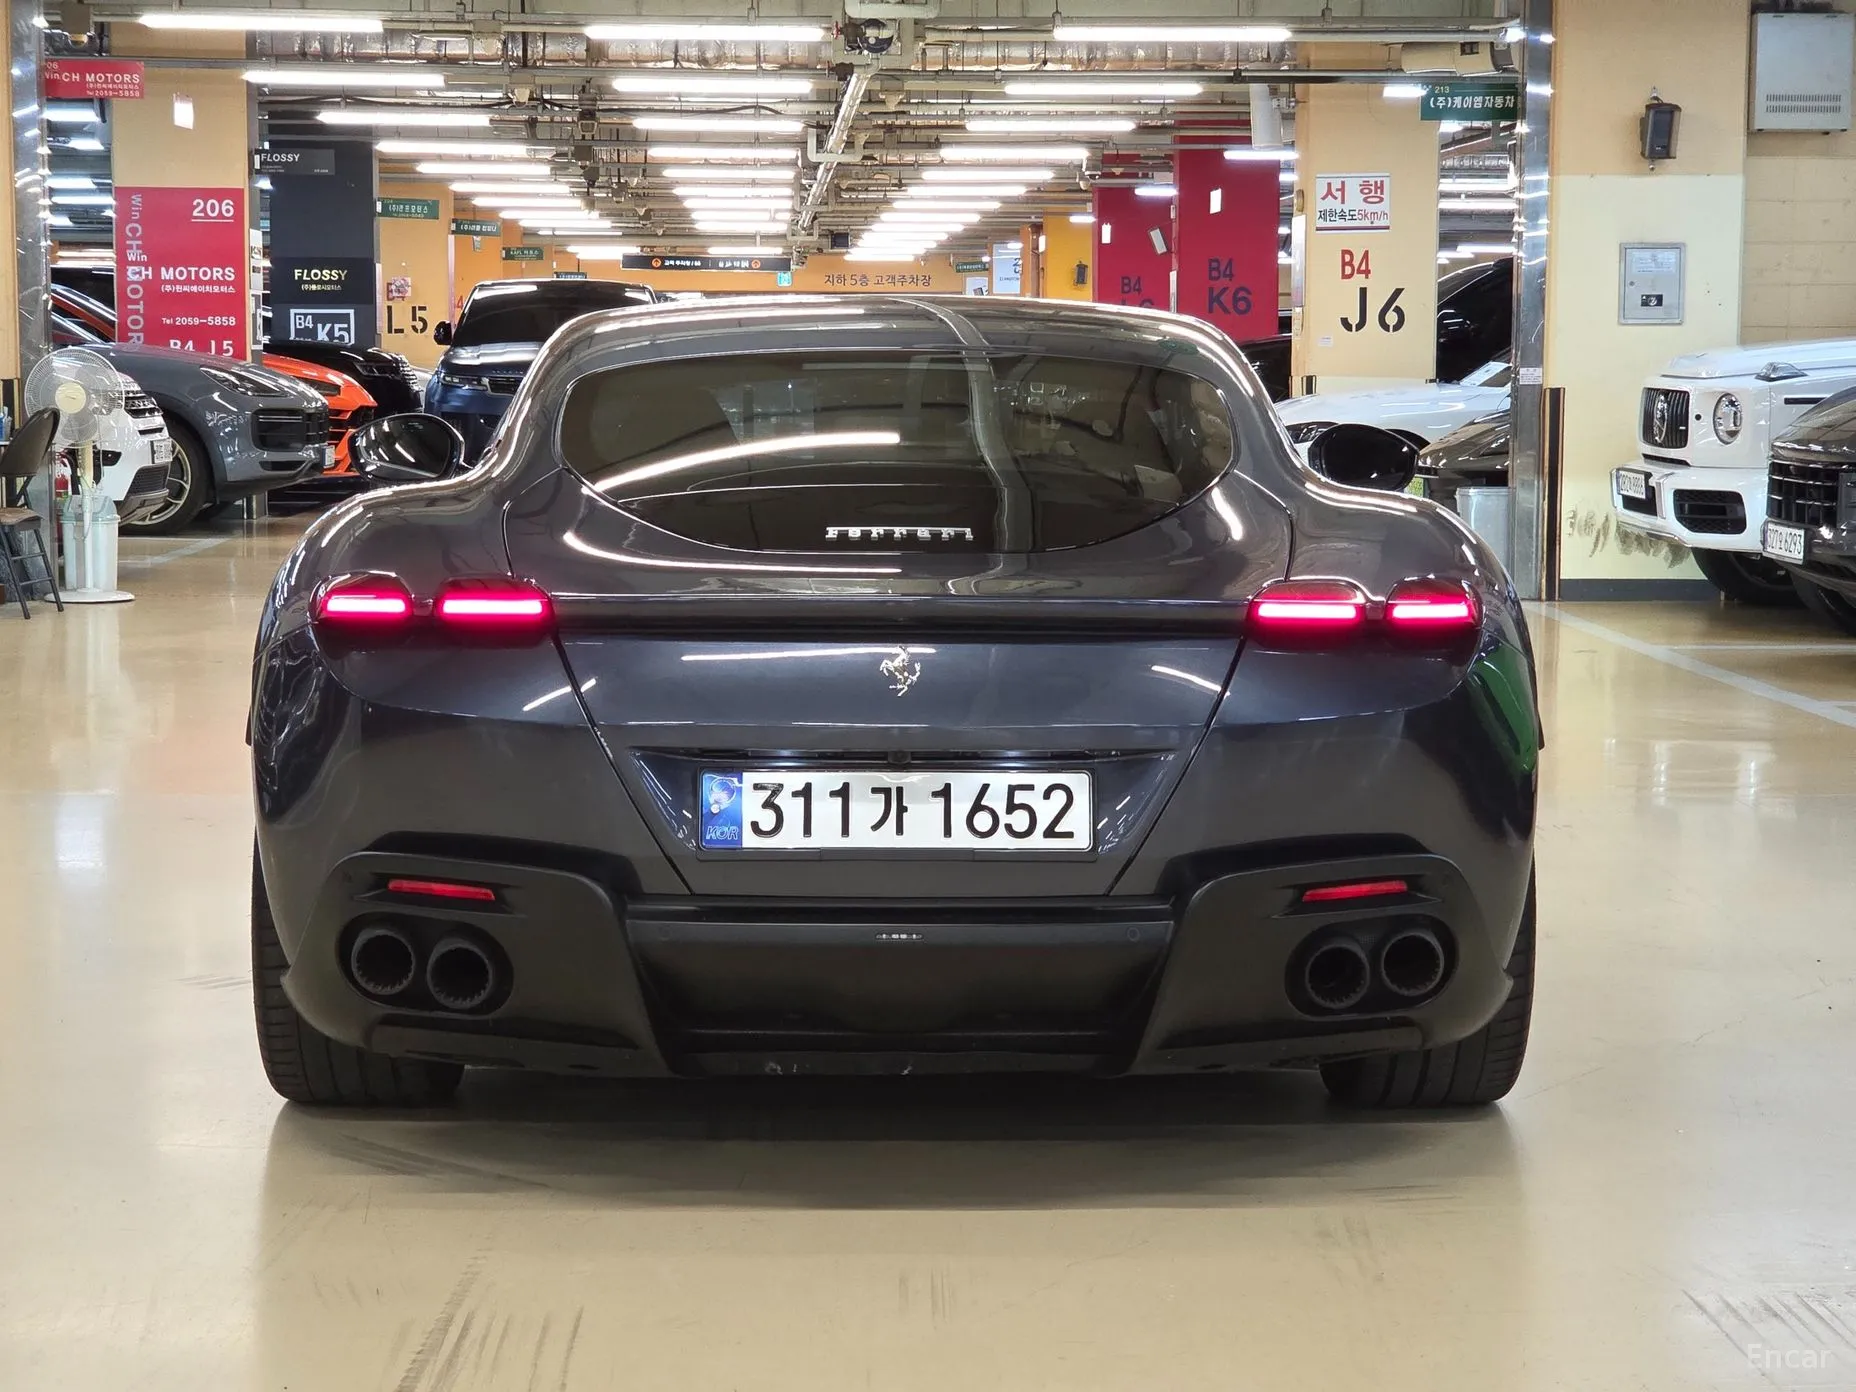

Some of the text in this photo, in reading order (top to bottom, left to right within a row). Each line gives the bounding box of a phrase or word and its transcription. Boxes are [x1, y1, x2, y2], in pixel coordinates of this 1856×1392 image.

[46, 61, 59, 70] 06
[85, 73, 140, 84] MOTORS
[1434, 86, 1450, 94] 213
[1429, 95, 1515, 109] (주)케이엠자동차
[261, 153, 300, 162] FLOSSY
[191, 198, 235, 217] 206
[126, 250, 148, 262] Win
[1208, 257, 1235, 282] B4
[1341, 249, 1371, 280] B4
[127, 266, 153, 280] CH
[161, 266, 236, 281] MOTORS
[294, 269, 348, 281] FLOSSY
[824, 274, 932, 287] 지하 5층 고객주차장
[1121, 276, 1143, 296] B4
[1208, 286, 1253, 316] K6
[1340, 287, 1406, 333] J6
[161, 315, 236, 327] Tel 2059-5858
[295, 314, 314, 329] B4
[317, 323, 350, 344] K5
[825, 526, 974, 541] Ferrari
[705, 825, 739, 841] KOR
